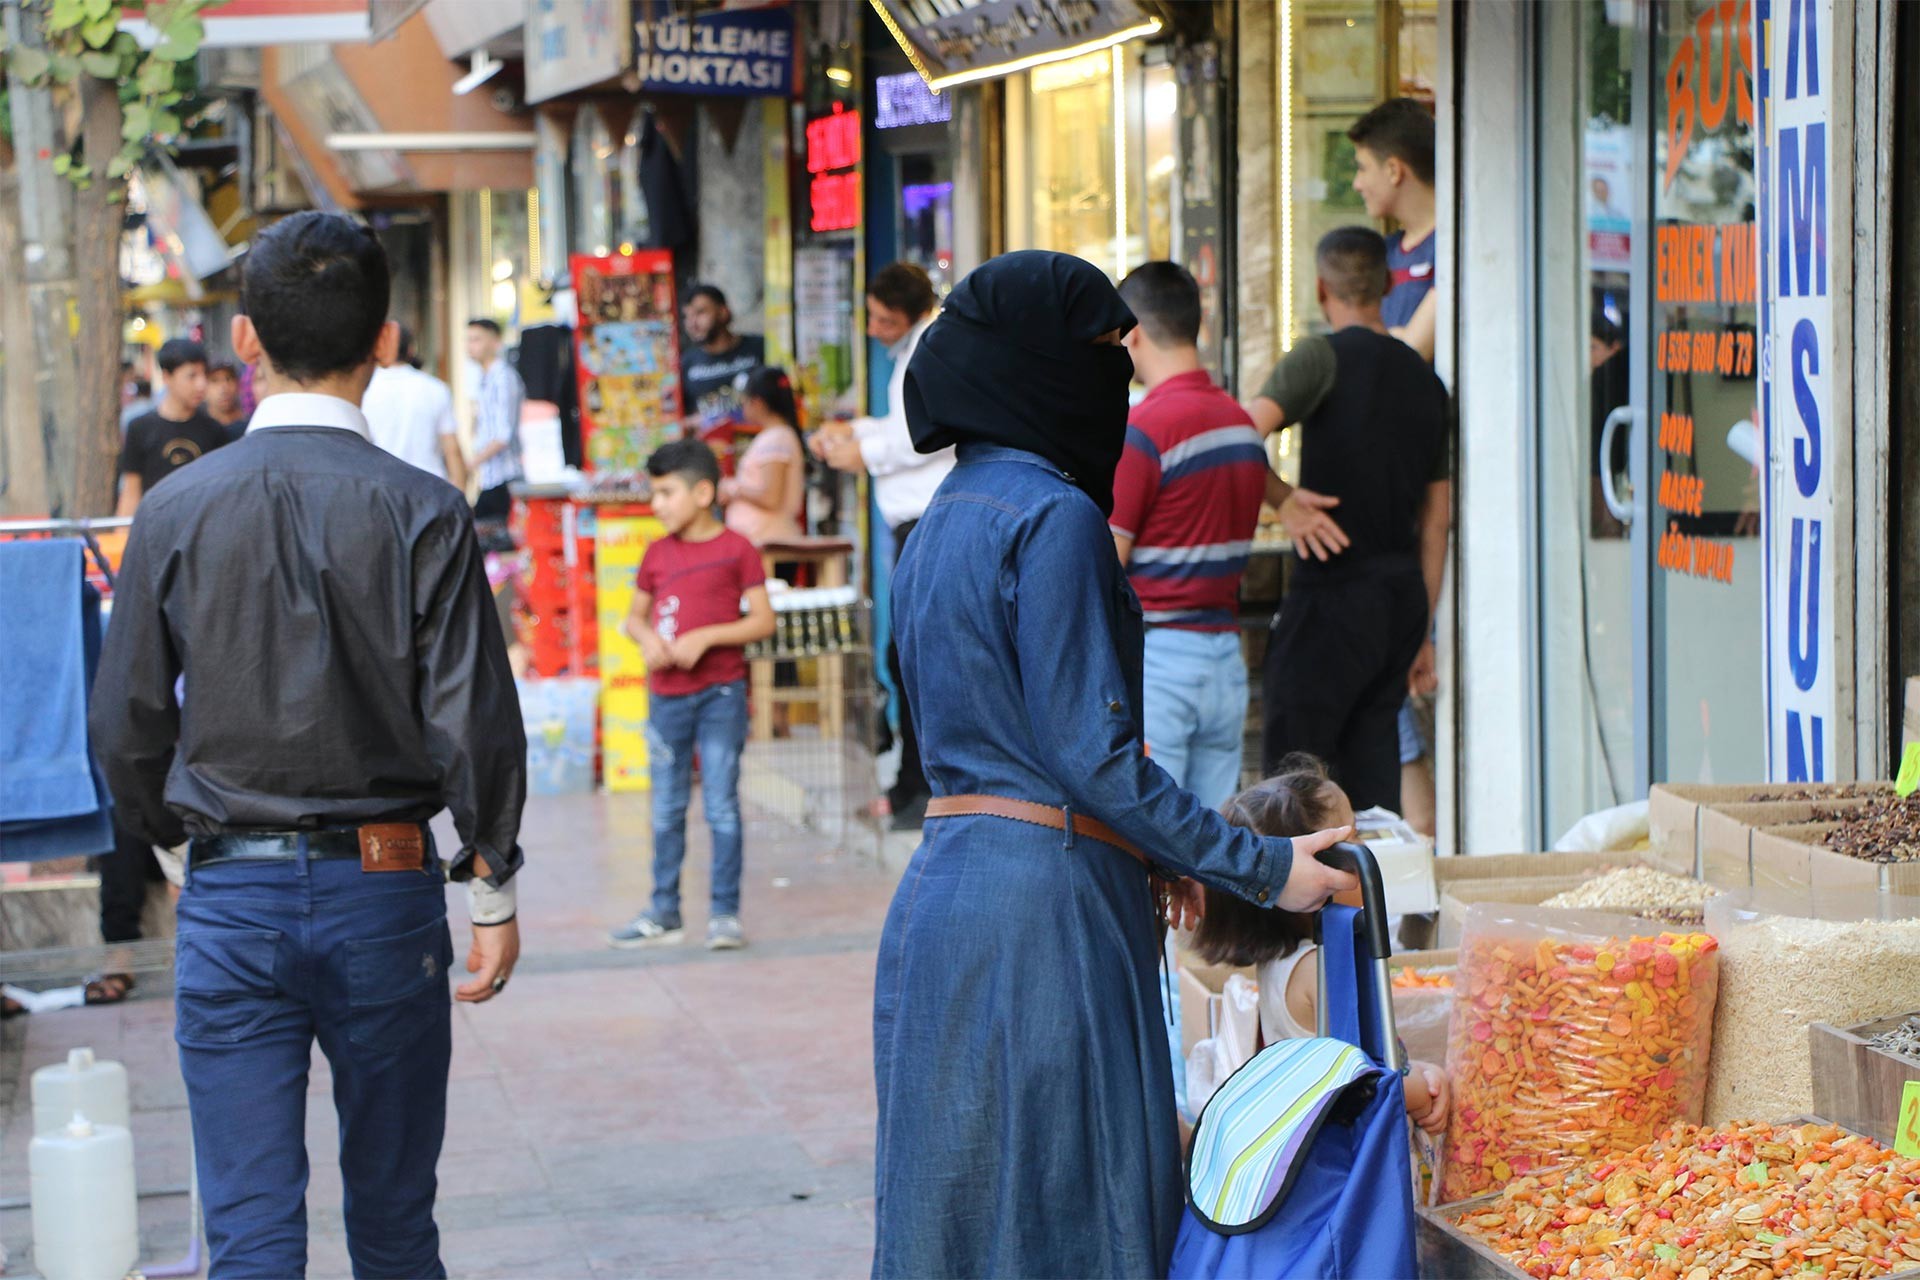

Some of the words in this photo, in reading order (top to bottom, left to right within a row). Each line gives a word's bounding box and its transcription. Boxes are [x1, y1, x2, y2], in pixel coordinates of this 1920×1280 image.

[635, 15, 789, 57] YÜKLEME
[637, 51, 783, 89] NOKTASI
[1657, 224, 1716, 302] ERKEK
[1657, 331, 1667, 371] 0
[1668, 331, 1691, 372] 535
[1692, 331, 1716, 373] 680
[1717, 331, 1735, 375] 46
[1735, 331, 1753, 376] 73
